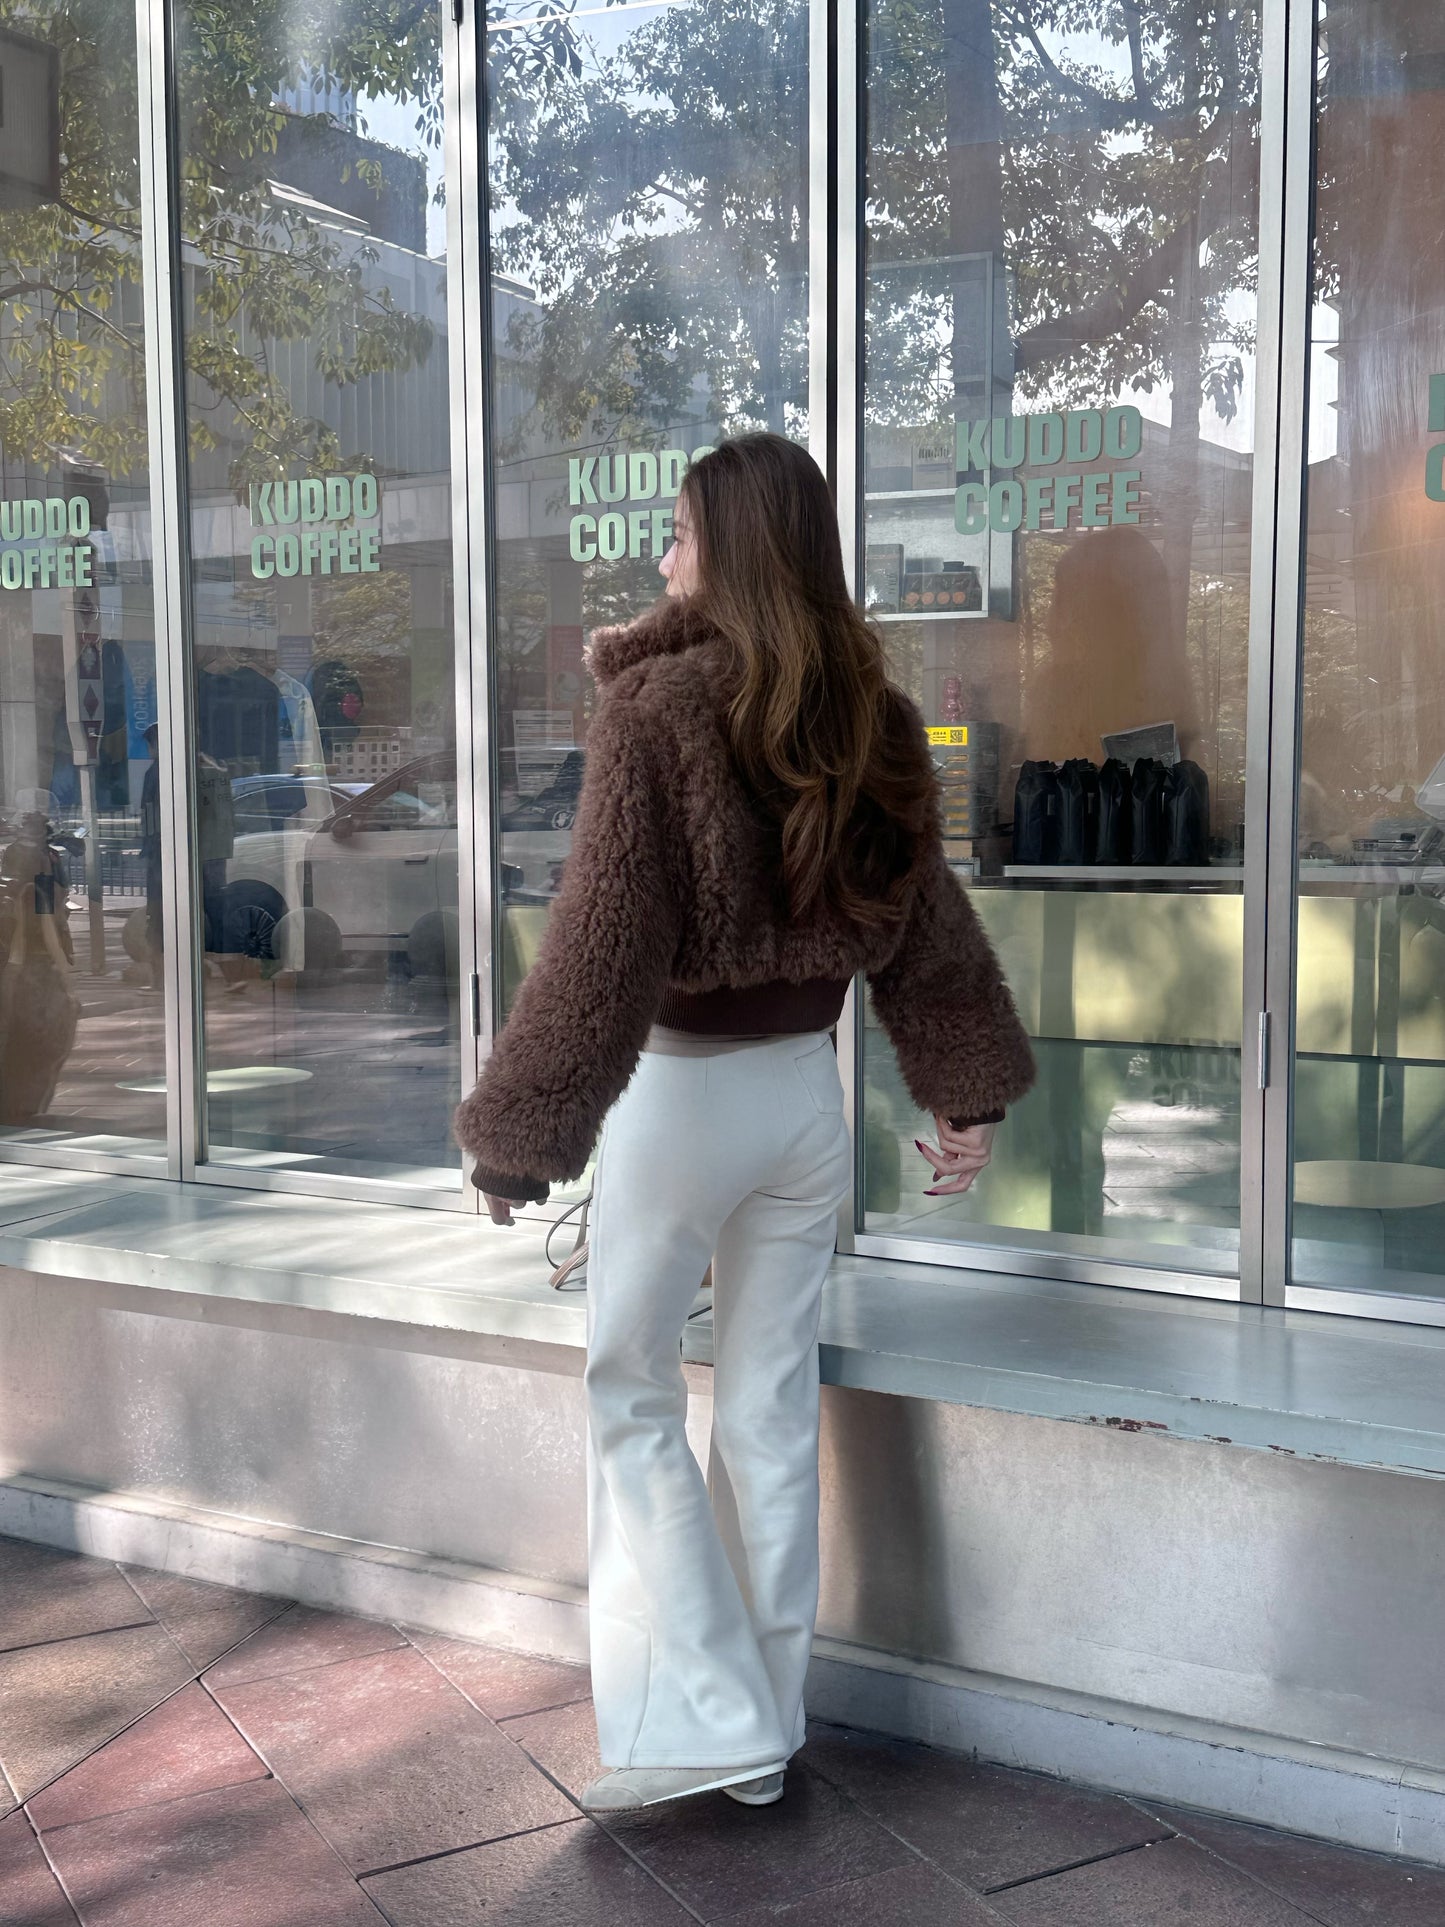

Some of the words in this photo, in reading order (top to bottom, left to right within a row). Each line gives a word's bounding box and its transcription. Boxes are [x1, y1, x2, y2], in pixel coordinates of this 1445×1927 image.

[954, 405, 1142, 472] KUDDO
[249, 474, 378, 527] KUDDO
[954, 471, 1141, 535] COFFEE
[0, 546, 93, 590] OFFEE
[251, 528, 381, 579] COFFEE
